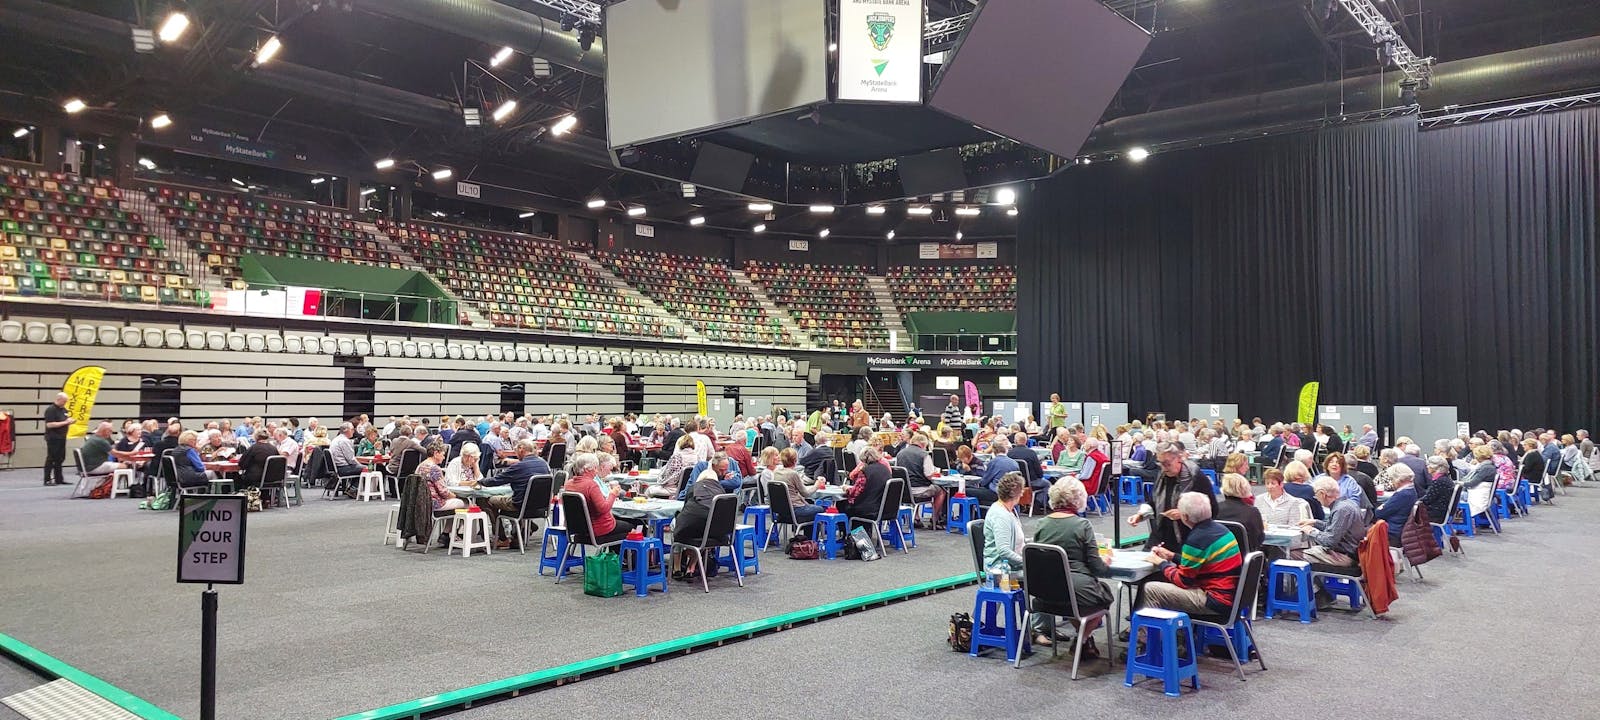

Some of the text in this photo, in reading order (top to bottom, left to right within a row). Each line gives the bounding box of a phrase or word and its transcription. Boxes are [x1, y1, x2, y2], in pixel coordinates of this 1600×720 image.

[226, 145, 267, 158] MyStateBank
[459, 184, 479, 195] UL10
[637, 226, 652, 235] UL11
[790, 241, 807, 249] UL12
[866, 357, 906, 365] MyStateBank
[940, 358, 982, 366] MyStateBank
[77, 380, 95, 421] PAIRS
[192, 510, 232, 521] MIND
[191, 531, 232, 543] YOUR
[193, 552, 228, 564] STEP
